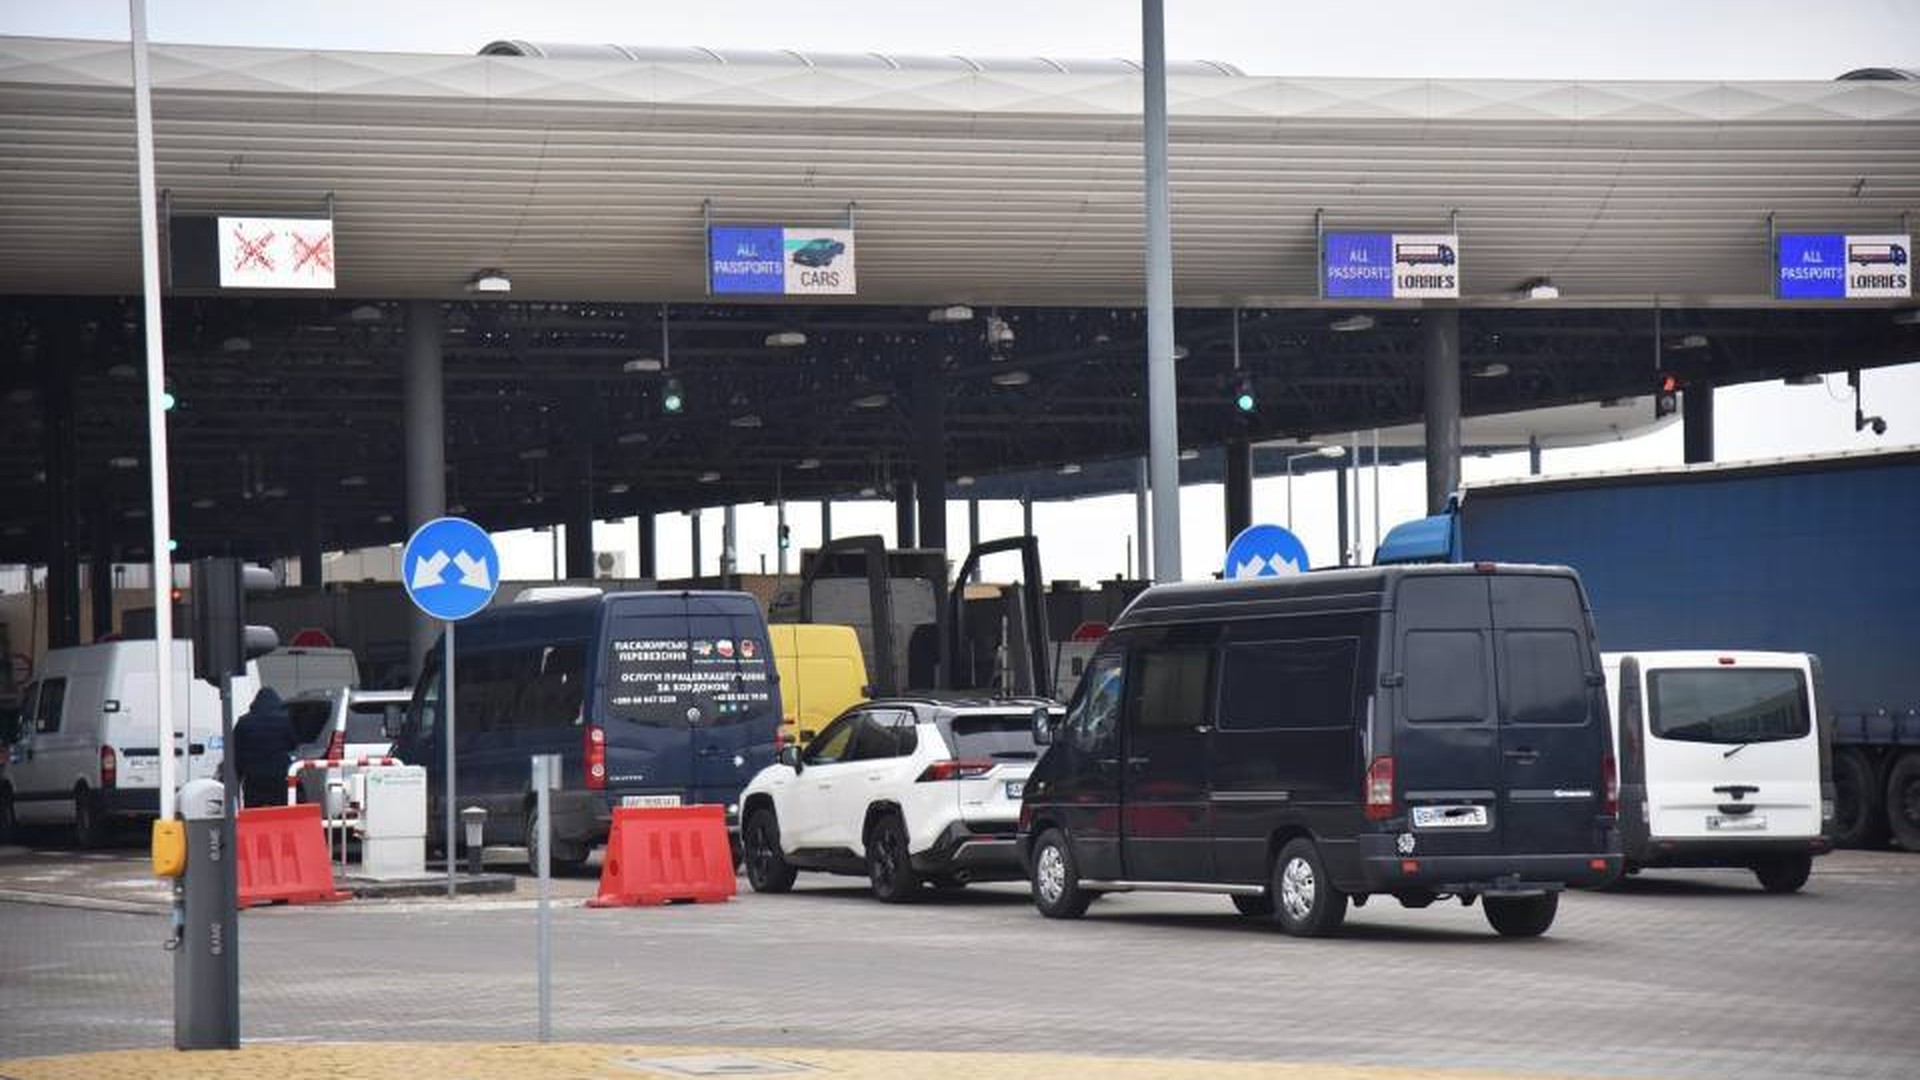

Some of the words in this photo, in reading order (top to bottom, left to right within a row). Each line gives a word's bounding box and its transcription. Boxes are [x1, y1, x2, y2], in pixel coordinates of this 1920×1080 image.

[737, 244, 759, 258] ALL
[1350, 249, 1368, 262] ALL
[1803, 251, 1823, 263] ALL
[714, 260, 783, 276] PASSPORTS
[1328, 265, 1391, 280] PASSPORTS
[1780, 266, 1844, 280] PASSPORTS
[800, 270, 840, 287] CARS
[1398, 274, 1455, 290] LORRIES
[1850, 274, 1908, 290] LORRIES
